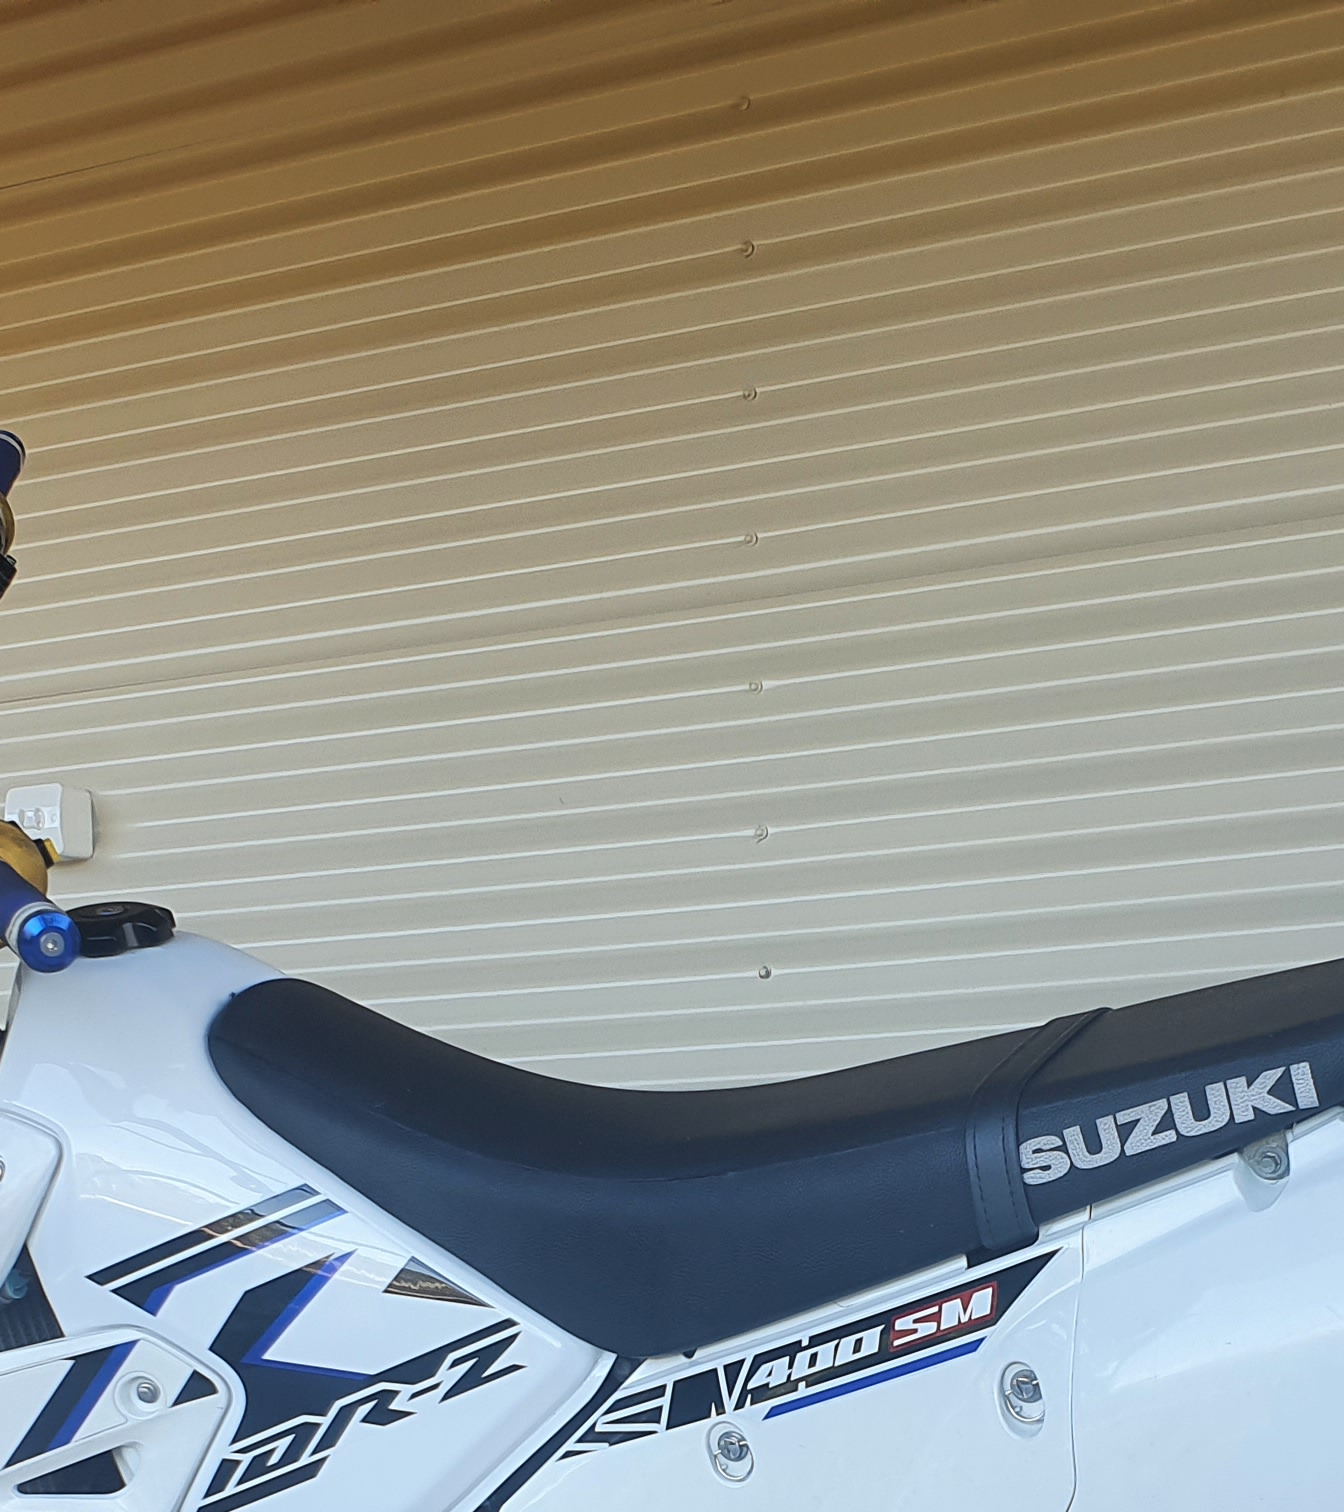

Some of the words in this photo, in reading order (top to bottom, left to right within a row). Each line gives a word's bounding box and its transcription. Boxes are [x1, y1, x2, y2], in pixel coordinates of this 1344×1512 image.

[1018, 1060, 1321, 1187] SUZUKI
[746, 1323, 887, 1391] 400
[892, 1285, 994, 1347] SM
[202, 1329, 529, 1501] DR-Z
